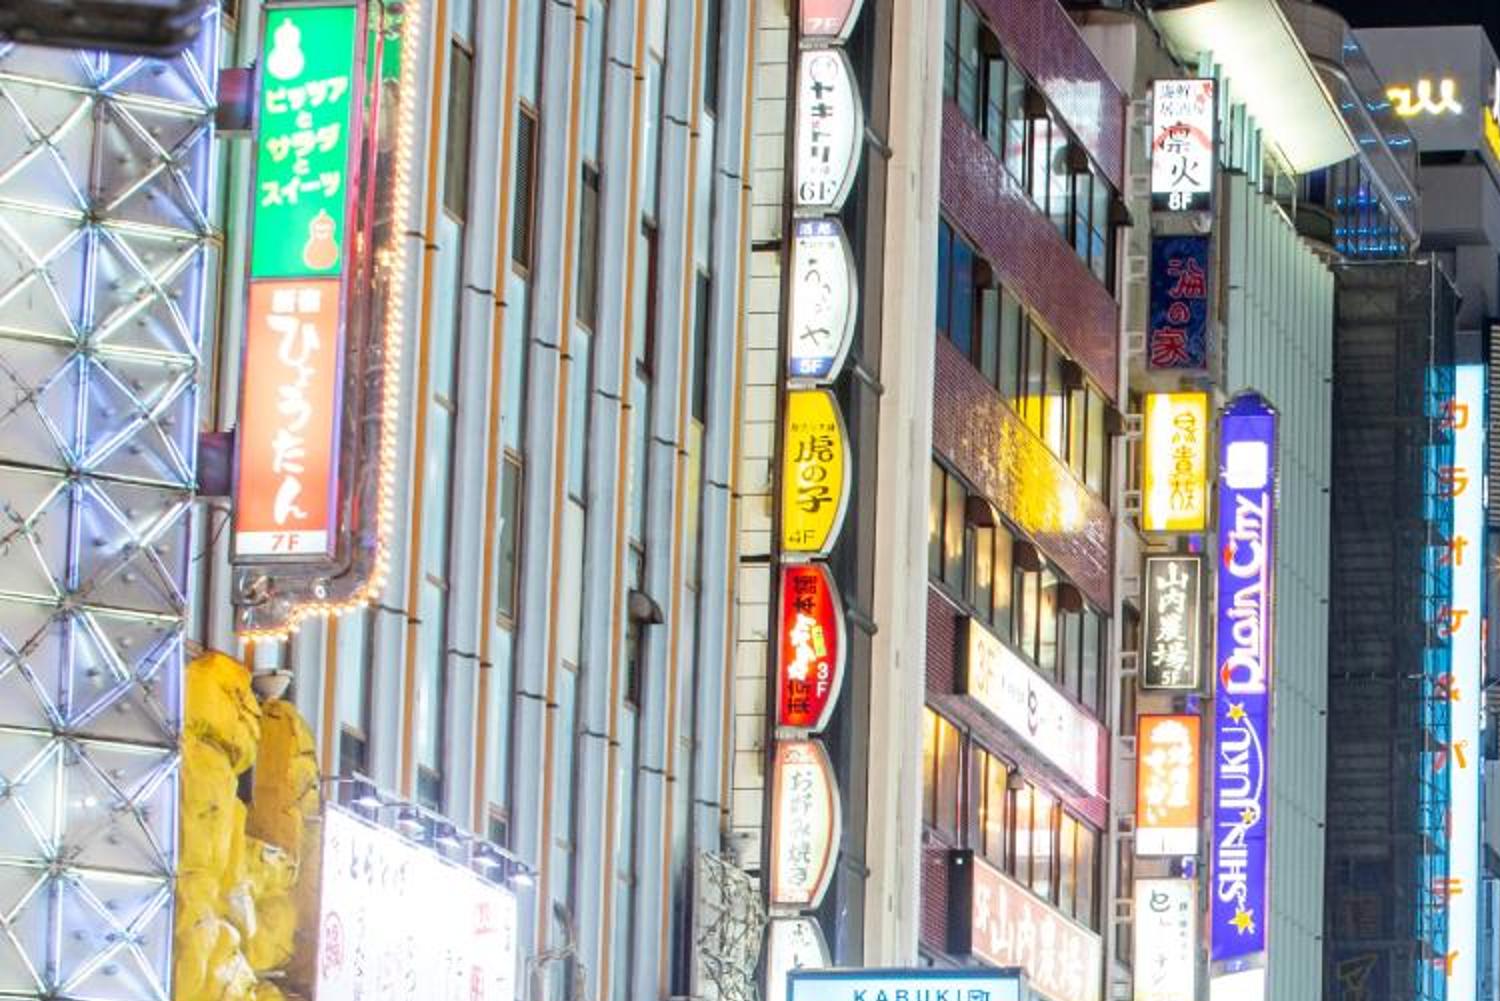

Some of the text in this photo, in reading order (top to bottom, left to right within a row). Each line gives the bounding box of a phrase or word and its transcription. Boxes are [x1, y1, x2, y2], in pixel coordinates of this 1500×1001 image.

[265, 126, 340, 161] サラダ
[260, 174, 341, 208] スイーツ
[267, 314, 321, 524] ひょうたん
[793, 434, 834, 514] 虎の子
[1218, 725, 1258, 904] SHINJUKU
